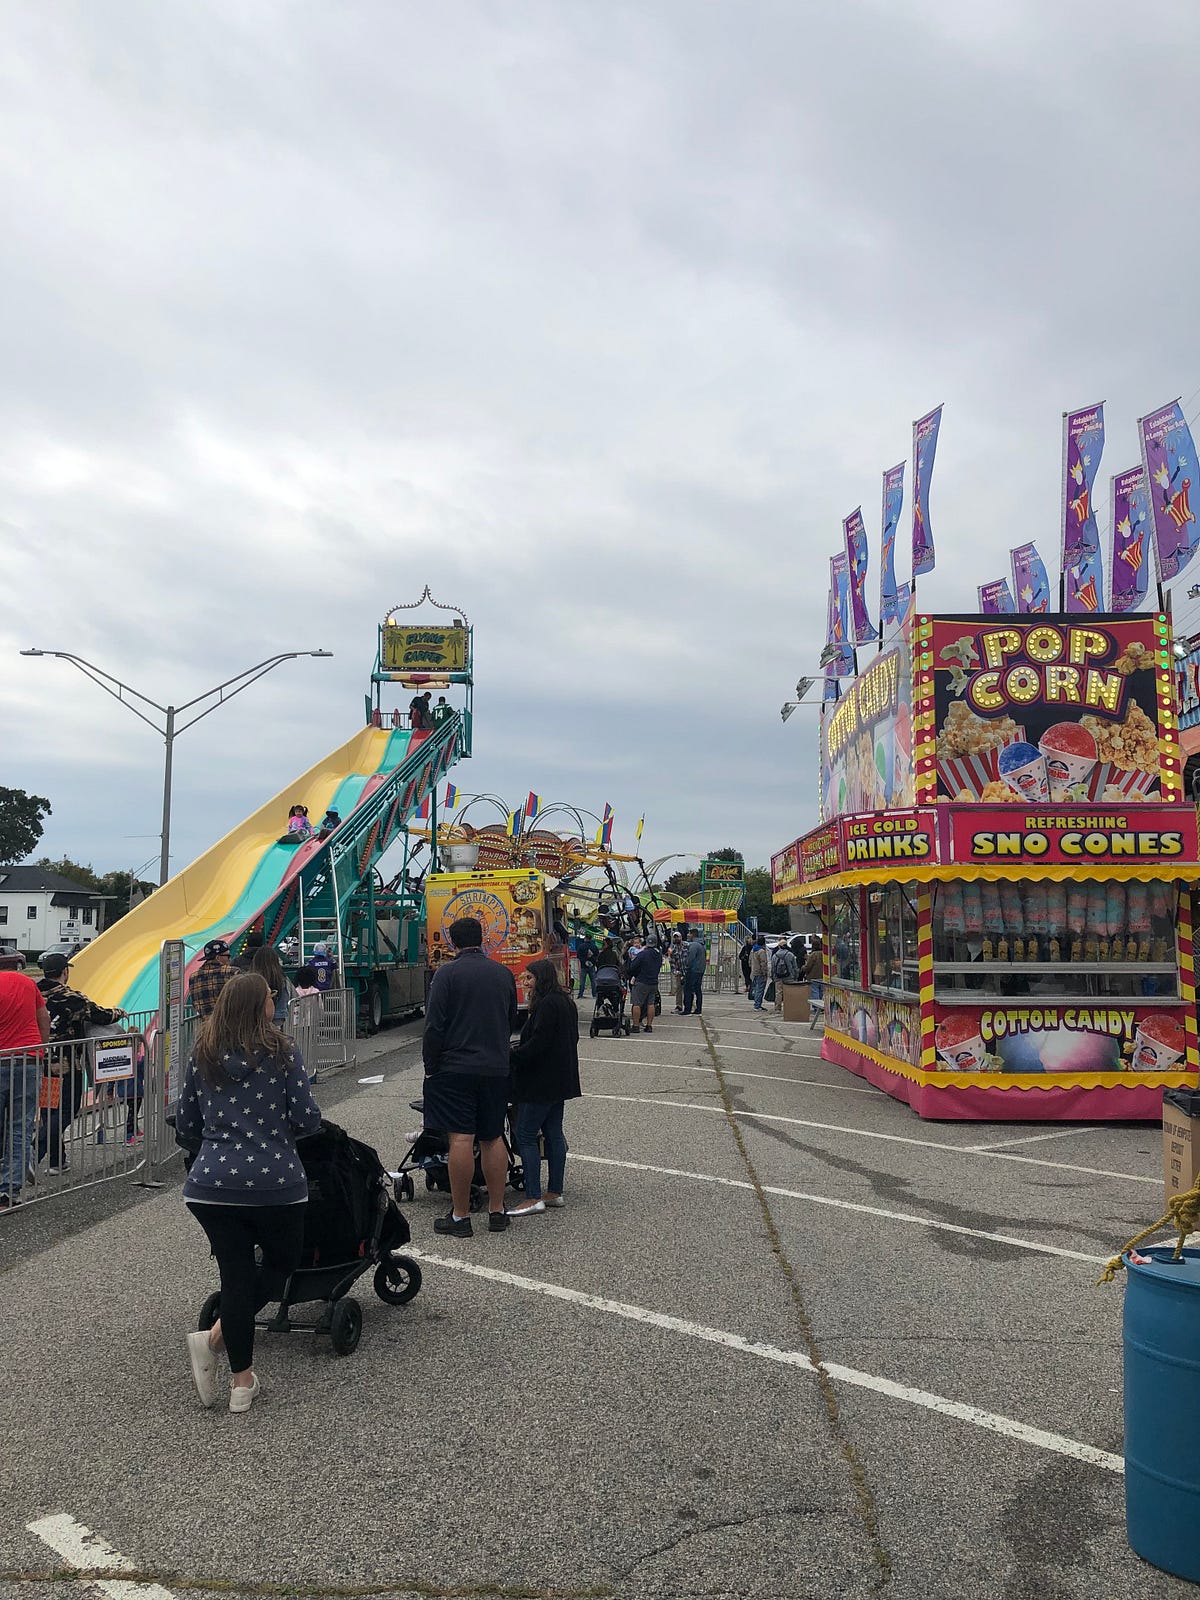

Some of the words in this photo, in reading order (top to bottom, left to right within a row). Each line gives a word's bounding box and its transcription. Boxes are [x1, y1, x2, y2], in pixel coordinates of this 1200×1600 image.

[1149, 413, 1176, 429] Established
[406, 632, 445, 645] FLYING
[982, 626, 1108, 669] POP
[403, 651, 447, 664] CARPET
[859, 653, 899, 724] CANDY
[971, 665, 1122, 710] CORN
[435, 709, 444, 719] 14
[849, 824, 868, 837] ICE
[873, 819, 919, 834] COLD
[1025, 816, 1127, 829] REFRESHING
[847, 833, 930, 861] DRINKS
[972, 832, 1049, 855] SNO
[1060, 832, 1183, 855] CONES
[479, 850, 509, 861] ORNADO
[318, 968, 326, 982] 8
[980, 1009, 1059, 1041] COTTON
[1063, 1009, 1136, 1041] CANDY
